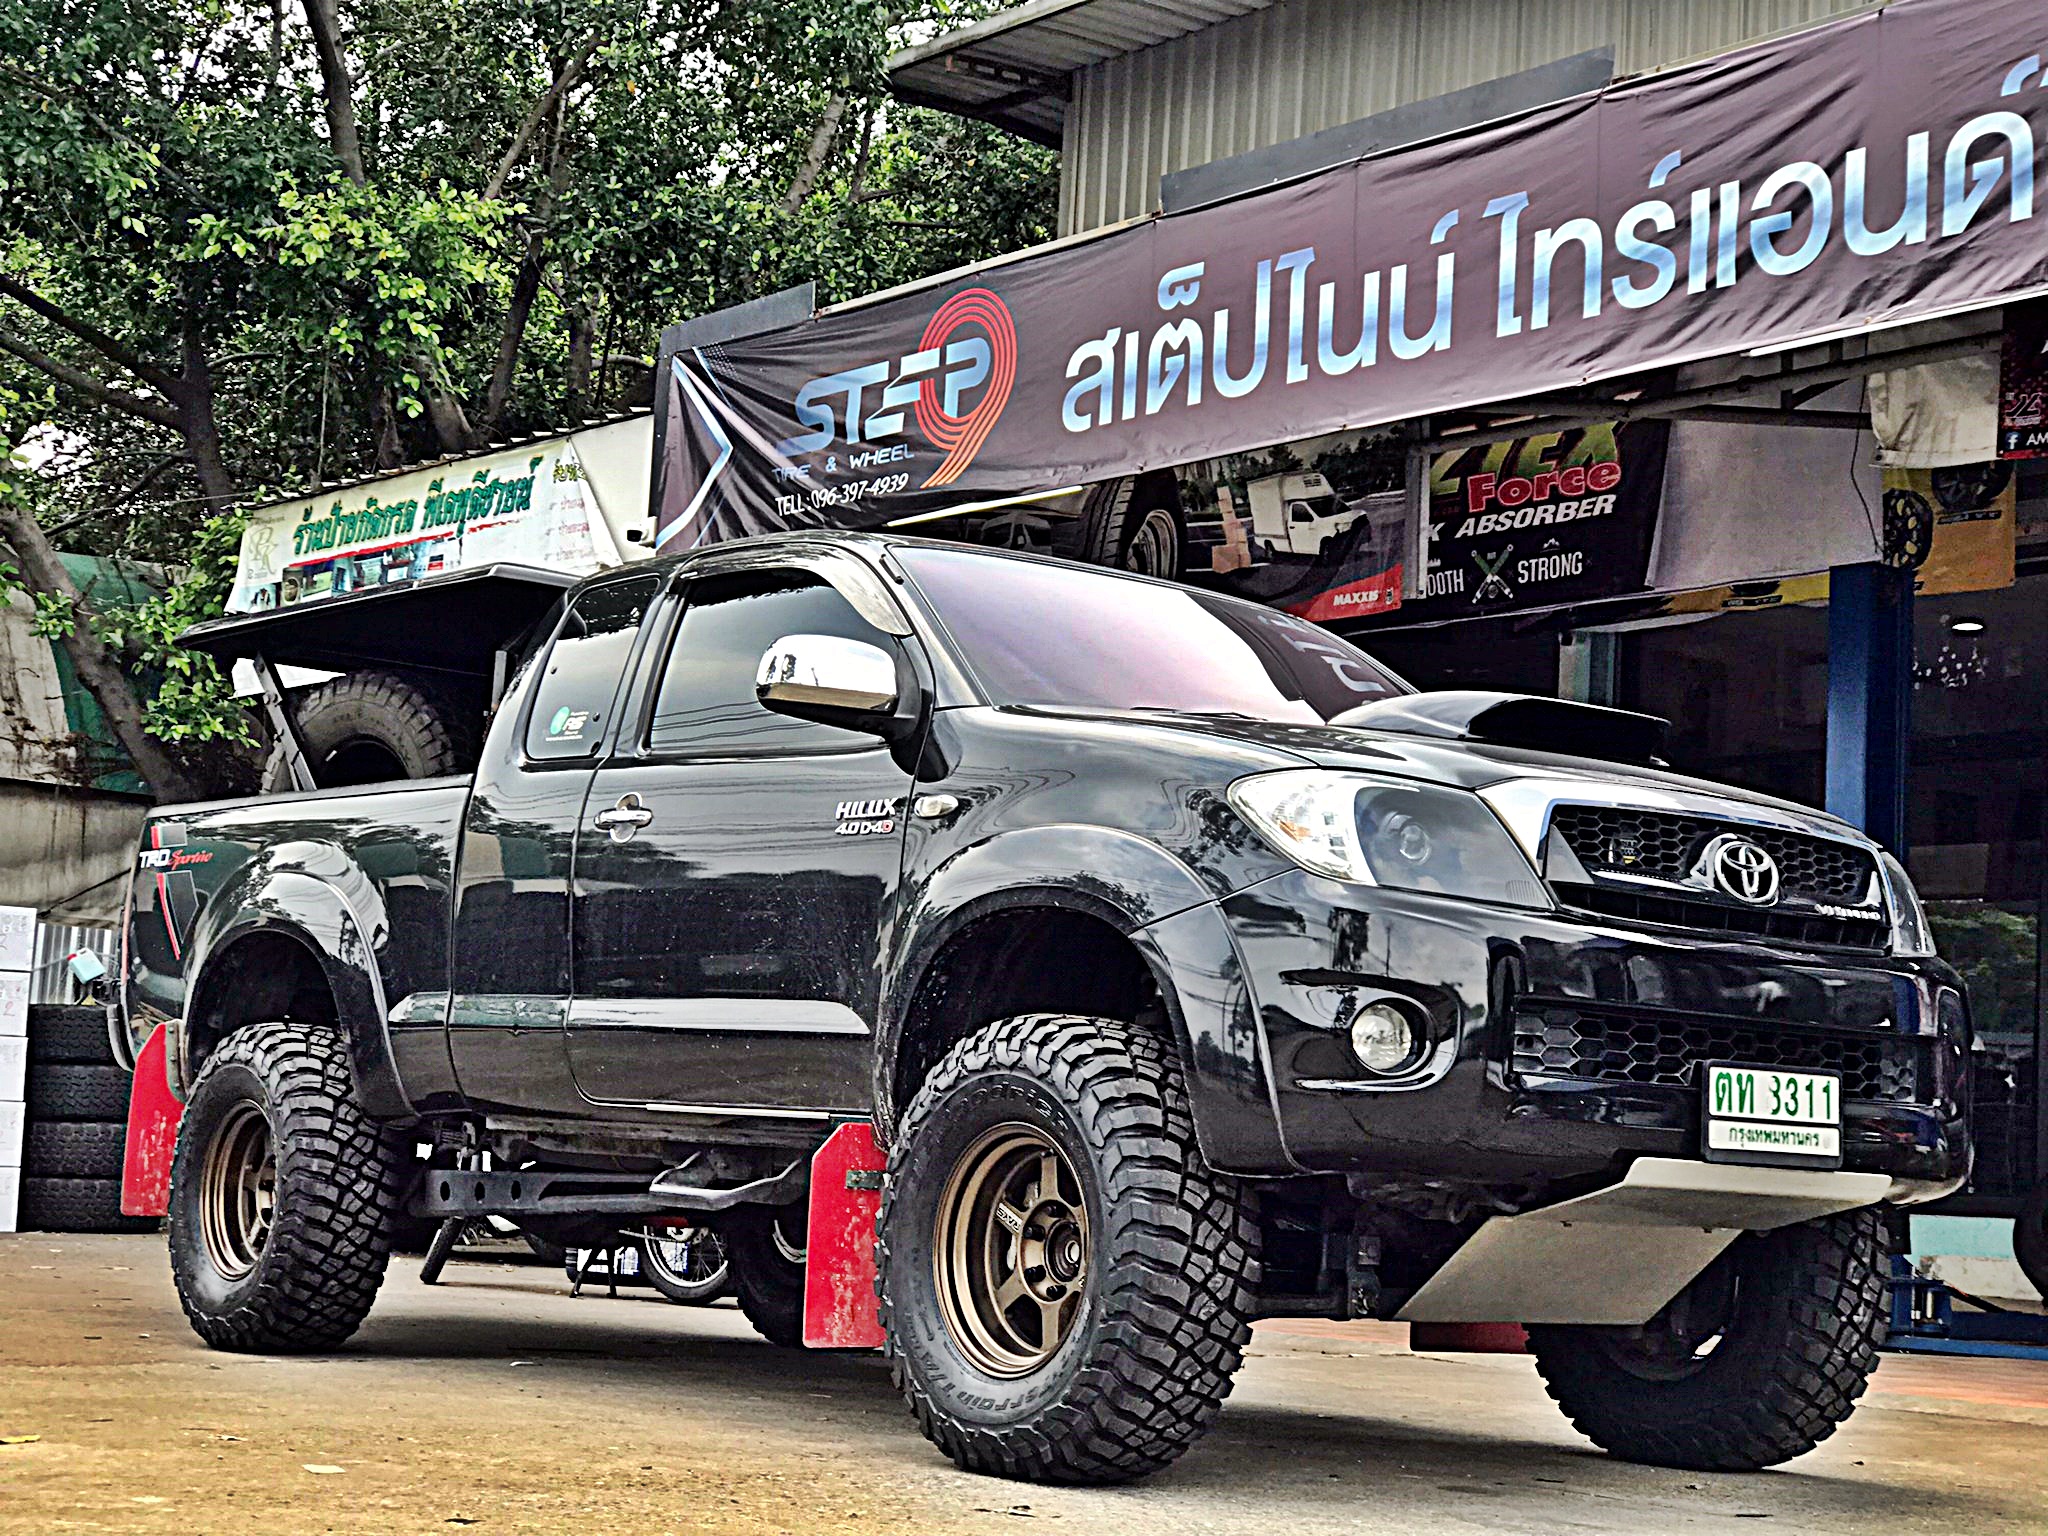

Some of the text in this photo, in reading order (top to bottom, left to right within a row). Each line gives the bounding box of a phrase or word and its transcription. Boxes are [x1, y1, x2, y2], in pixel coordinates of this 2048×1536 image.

[1482, 53, 2048, 339] ไทร์แอนด์
[825, 455, 838, 473] &
[849, 443, 916, 470] WHEEL
[1467, 461, 1622, 513] Force
[1454, 493, 1617, 539] ABSORBER
[1427, 568, 1465, 598] OOTH
[1517, 551, 1583, 584] STRONG
[1333, 589, 1379, 606] MAXXIS
[835, 797, 898, 820] HILUX
[1728, 1126, 1820, 1149] กรุงเทพมหานคร
